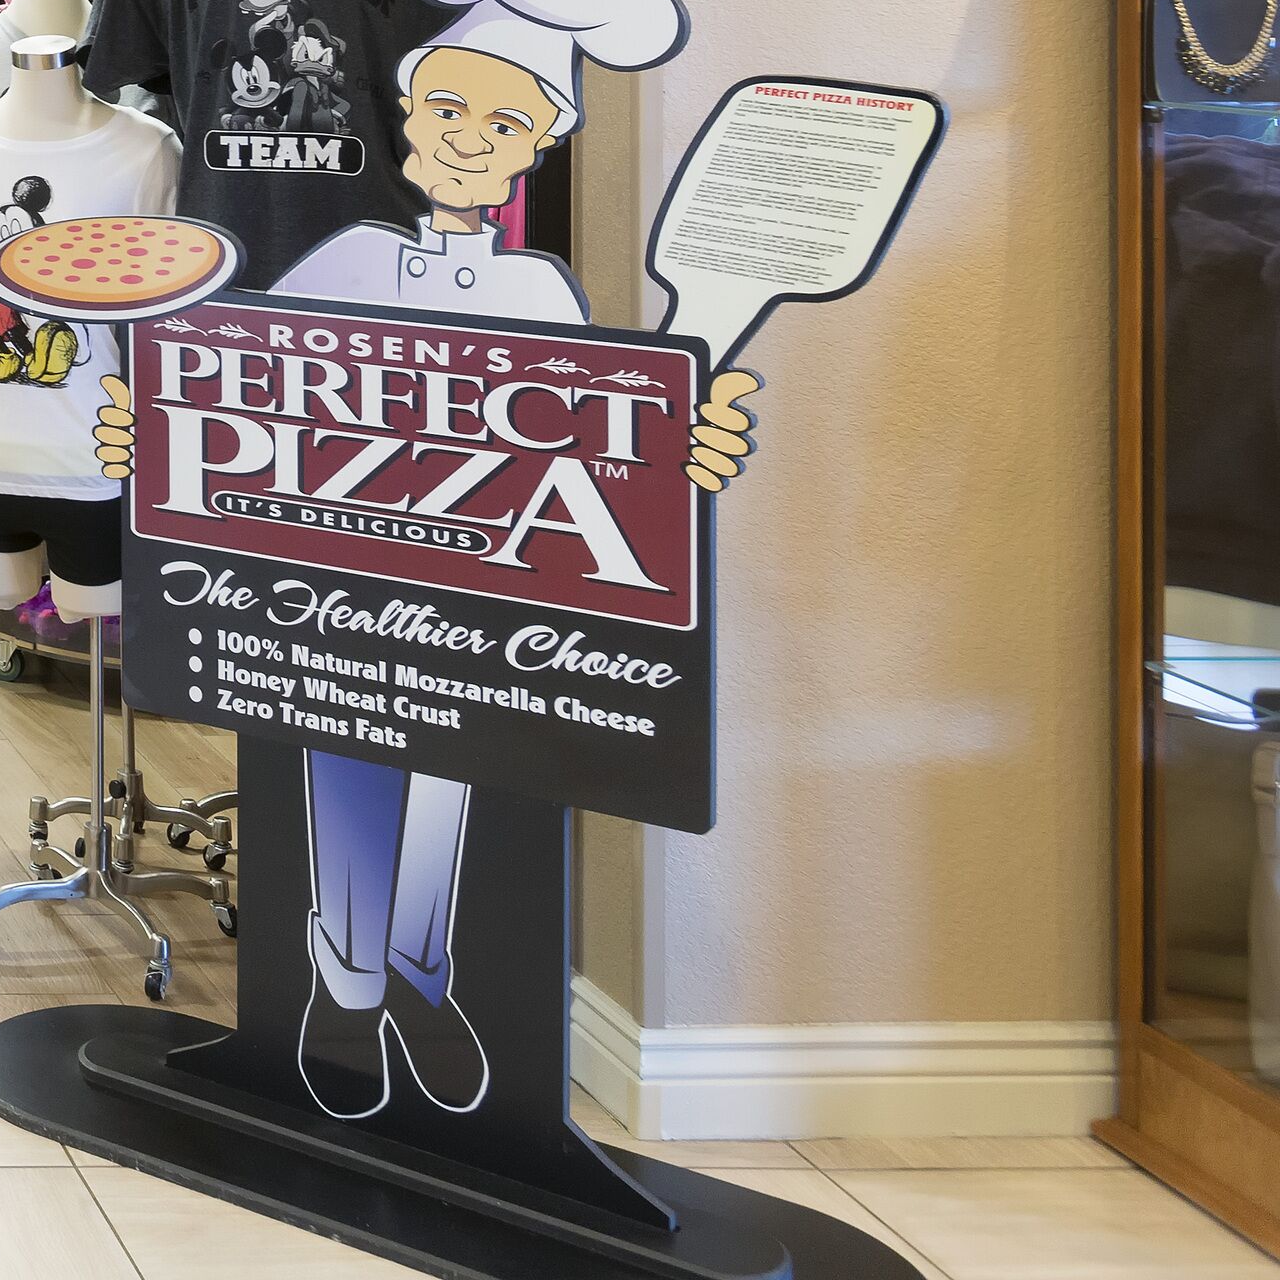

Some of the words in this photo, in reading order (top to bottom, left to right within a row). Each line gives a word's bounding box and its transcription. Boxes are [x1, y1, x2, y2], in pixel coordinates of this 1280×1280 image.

[754, 86, 810, 101] PERFECT
[812, 93, 852, 105] PIZZA
[856, 97, 915, 112] HISTORY
[219, 135, 342, 170] TEAM
[268, 322, 514, 373] ROSEN'S
[150, 338, 673, 465] PERFECT
[150, 403, 673, 592] PIZZA
[223, 496, 284, 518] IT'S
[300, 502, 473, 549] DELICIOUS
[160, 560, 261, 611] The
[265, 578, 498, 655] Healthier
[505, 625, 682, 690] Choice
[216, 629, 285, 662] 100%
[291, 643, 387, 682] Natural
[394, 665, 547, 716] Mozzarella
[553, 695, 657, 738] Cheese
[216, 659, 296, 697] Honey
[303, 676, 388, 716] Wheat
[393, 699, 462, 730] Crust
[216, 688, 274, 720] Zero
[279, 702, 350, 737] Trans
[355, 717, 408, 750] Fats
